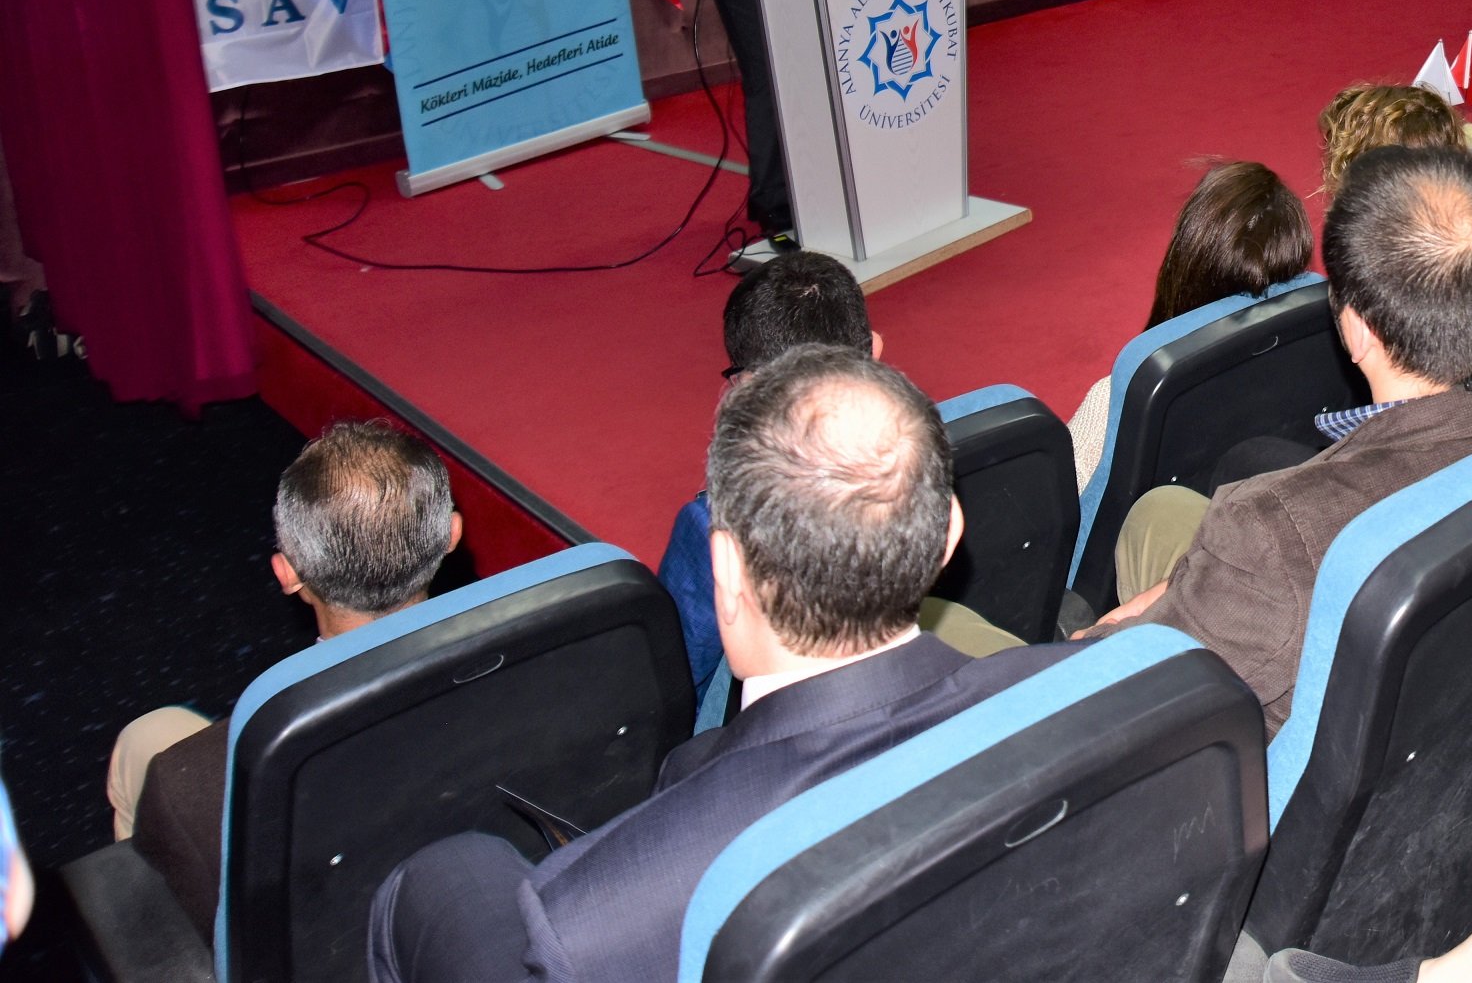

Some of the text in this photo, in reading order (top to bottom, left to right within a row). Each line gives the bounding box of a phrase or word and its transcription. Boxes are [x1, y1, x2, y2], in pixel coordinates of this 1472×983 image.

[420, 33, 619, 114] Kökleri Mâzide, Hedefleri Atide
[837, 24, 857, 95] ALANYA
[859, 74, 951, 129] ÜNİVERSİTESİ
